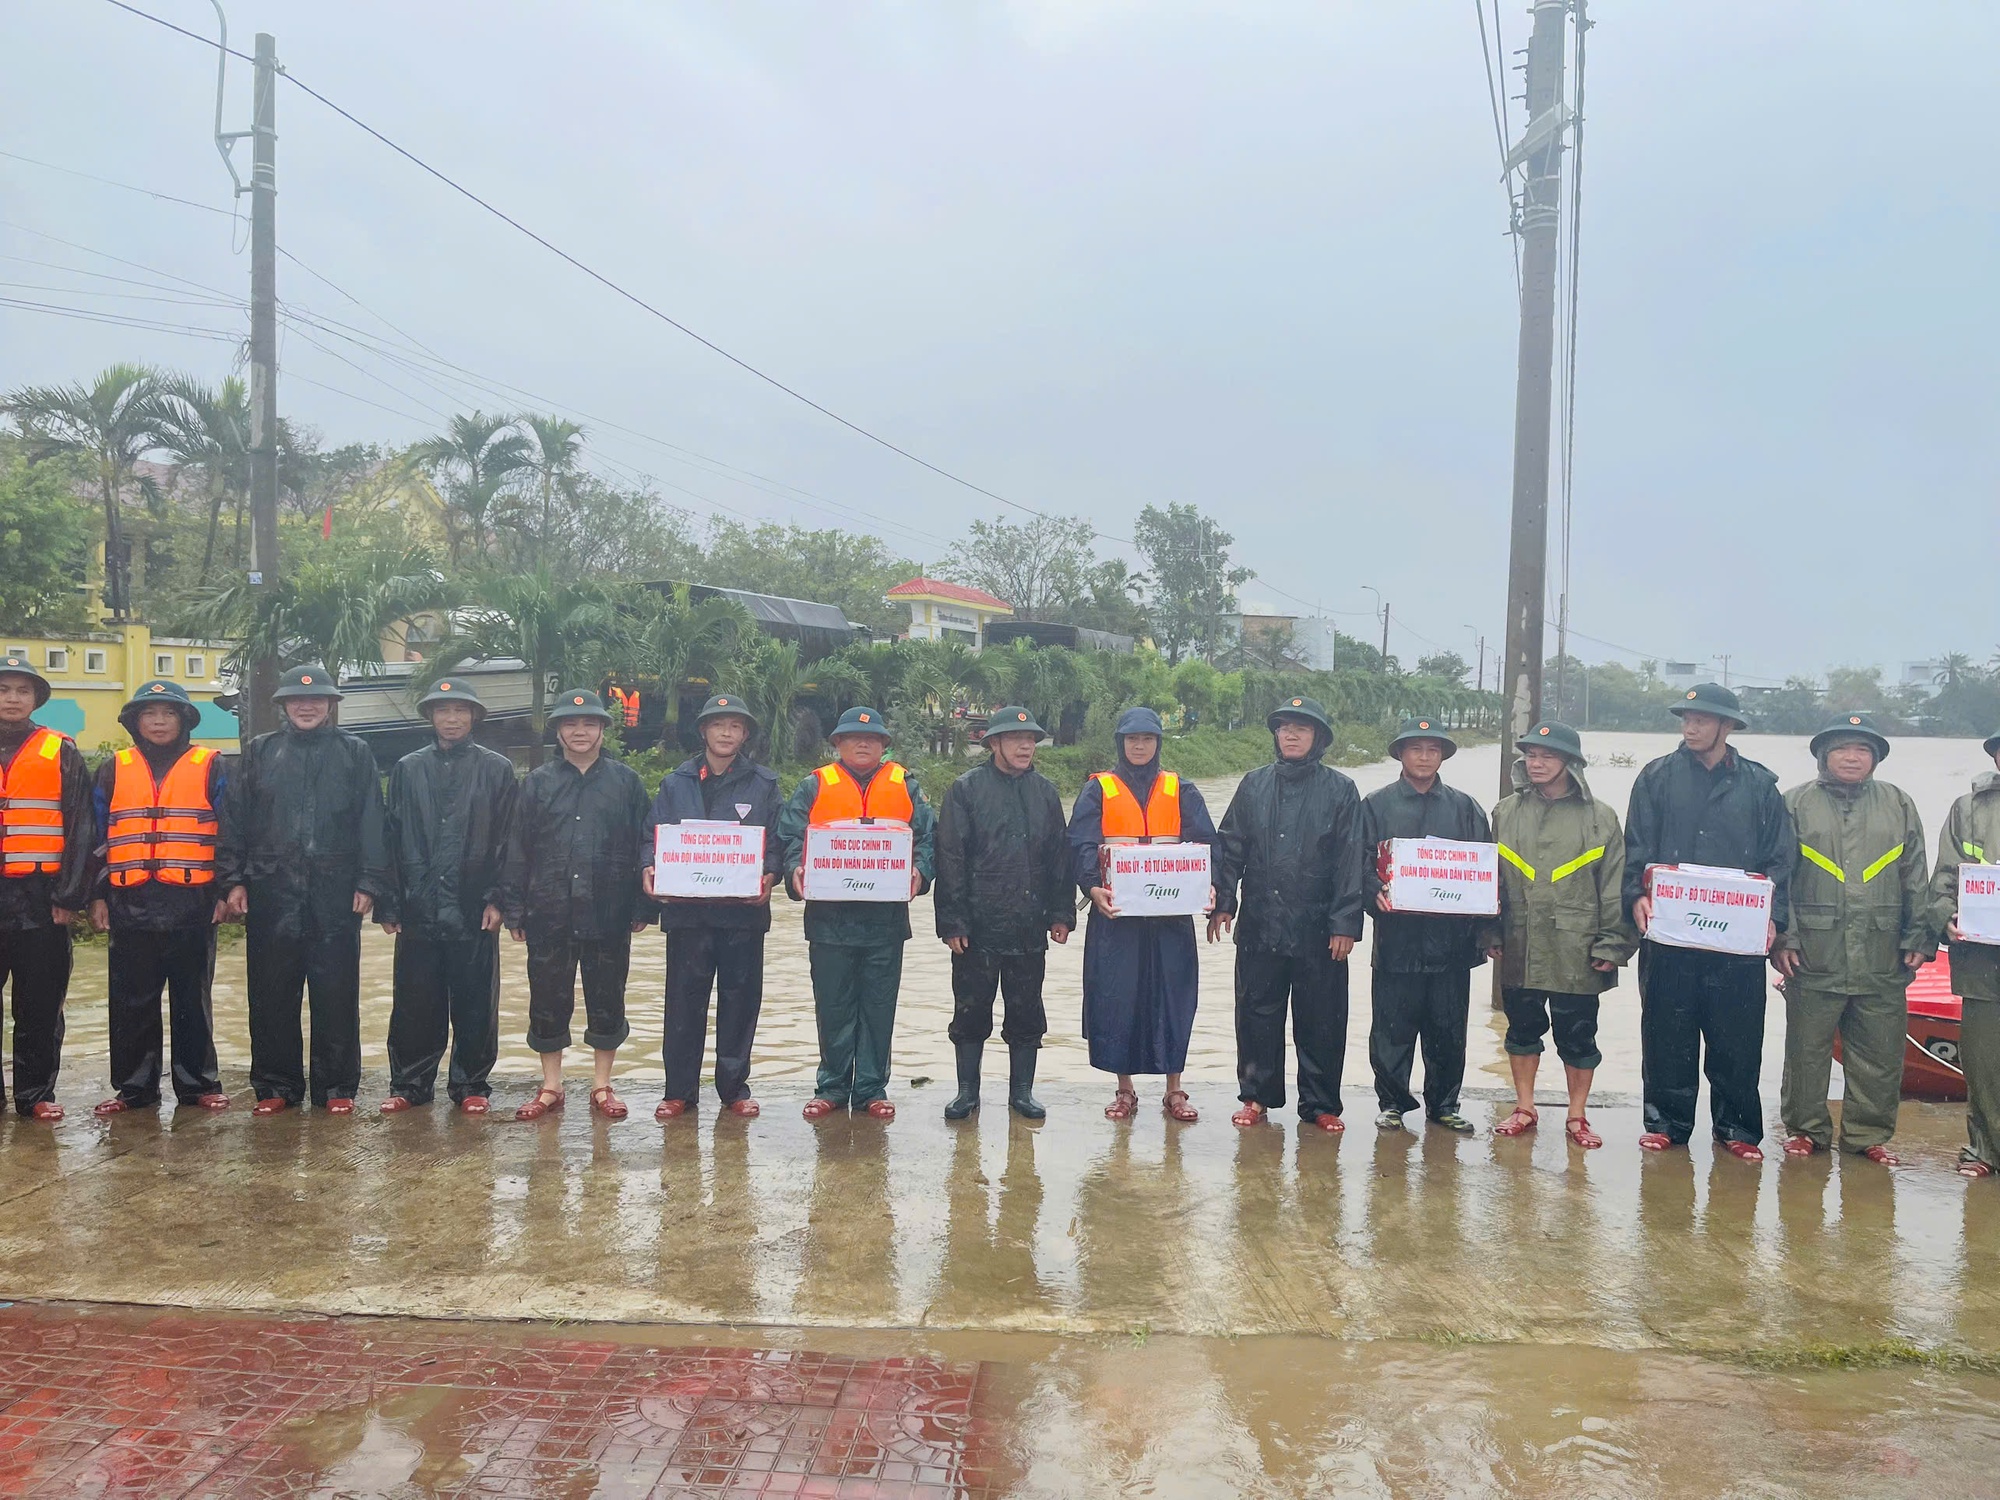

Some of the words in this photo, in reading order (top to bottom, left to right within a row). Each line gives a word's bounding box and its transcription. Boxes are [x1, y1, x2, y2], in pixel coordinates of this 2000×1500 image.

[681, 830, 696, 844] TỔNG
[698, 834, 710, 847] CỤC
[712, 833, 731, 845] CHÍNH
[733, 835, 742, 847] TRỊ
[831, 835, 846, 850] TỔNG
[848, 840, 860, 853] CỤC
[862, 838, 880, 850] CHÍNH
[883, 840, 891, 853] TRỊ
[663, 850, 679, 863] QUÂN
[681, 850, 692, 865] ĐỘI
[693, 850, 710, 863] NHÂN
[712, 850, 725, 863] DÂN
[727, 851, 740, 866] VIỆT
[741, 853, 755, 864] NAM
[1417, 844, 1433, 859] TỔNG
[1435, 849, 1447, 863] CỤC
[1448, 849, 1467, 862] CHÍNH
[1469, 852, 1478, 865] TRỊ
[814, 856, 830, 869] QUÂN
[832, 856, 842, 871] ĐỘI
[844, 856, 860, 869] NHÂN
[862, 856, 875, 869] DÂN
[877, 857, 890, 872] VIỆT
[891, 859, 905, 869] NAM
[1116, 857, 1131, 873] ĐẢNG
[1133, 856, 1140, 873] ỦY
[1145, 858, 1152, 875] BỘ
[1153, 859, 1160, 872] TƯ
[1161, 857, 1174, 875] LỆNH
[1176, 857, 1190, 873] QUÂN
[1191, 859, 1202, 872] KHU
[1203, 859, 1206, 871] 5
[692, 872, 724, 885] Tặng
[1401, 864, 1417, 877] QUÂN
[1419, 865, 1429, 880] ĐỘI
[1431, 866, 1448, 879] NHÂN
[1450, 867, 1462, 880] DÂN
[1464, 868, 1477, 883] VIỆT
[1478, 871, 1492, 882] NAM
[842, 878, 875, 891] Tặng
[1144, 884, 1180, 900] Tặng
[1966, 875, 1984, 894] ĐẢNG
[1987, 876, 1995, 894] ỦY
[1430, 888, 1462, 901] Tặng
[1657, 880, 1674, 898] ĐẢNG
[1675, 882, 1684, 899] ỦY
[1689, 886, 1698, 904] BỘ
[1700, 888, 1708, 902] TƯ
[1709, 887, 1725, 906] LỆNH
[1727, 890, 1745, 906] QUÂN
[1746, 894, 1759, 908] KHU
[1760, 896, 1764, 908] 5
[1685, 913, 1729, 932] Tặng
